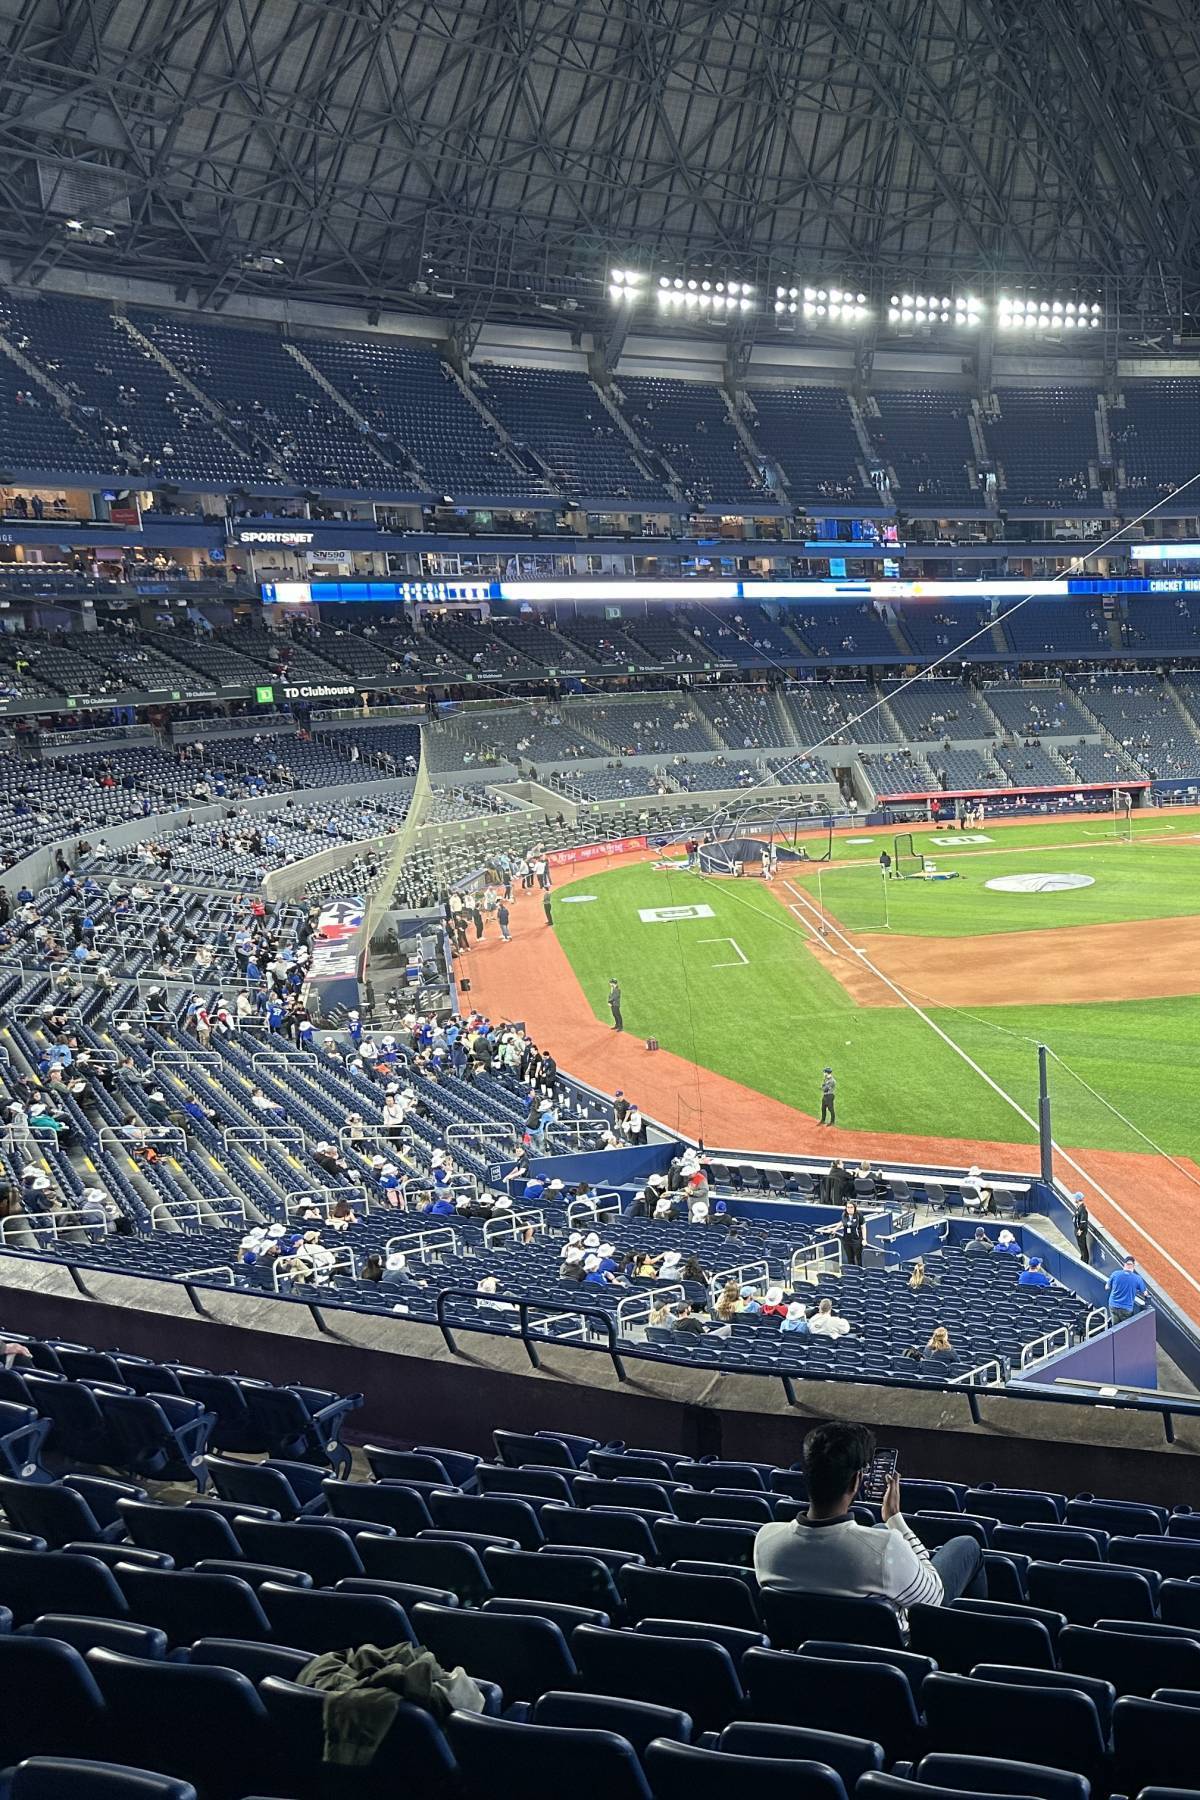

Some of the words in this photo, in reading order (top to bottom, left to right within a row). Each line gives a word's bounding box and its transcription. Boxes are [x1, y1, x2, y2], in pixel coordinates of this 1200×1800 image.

[240, 532, 314, 543] SPORTSNET
[1150, 580, 1183, 591] CRICKET
[283, 688, 299, 698] TD
[300, 685, 355, 697] Clubhouse
